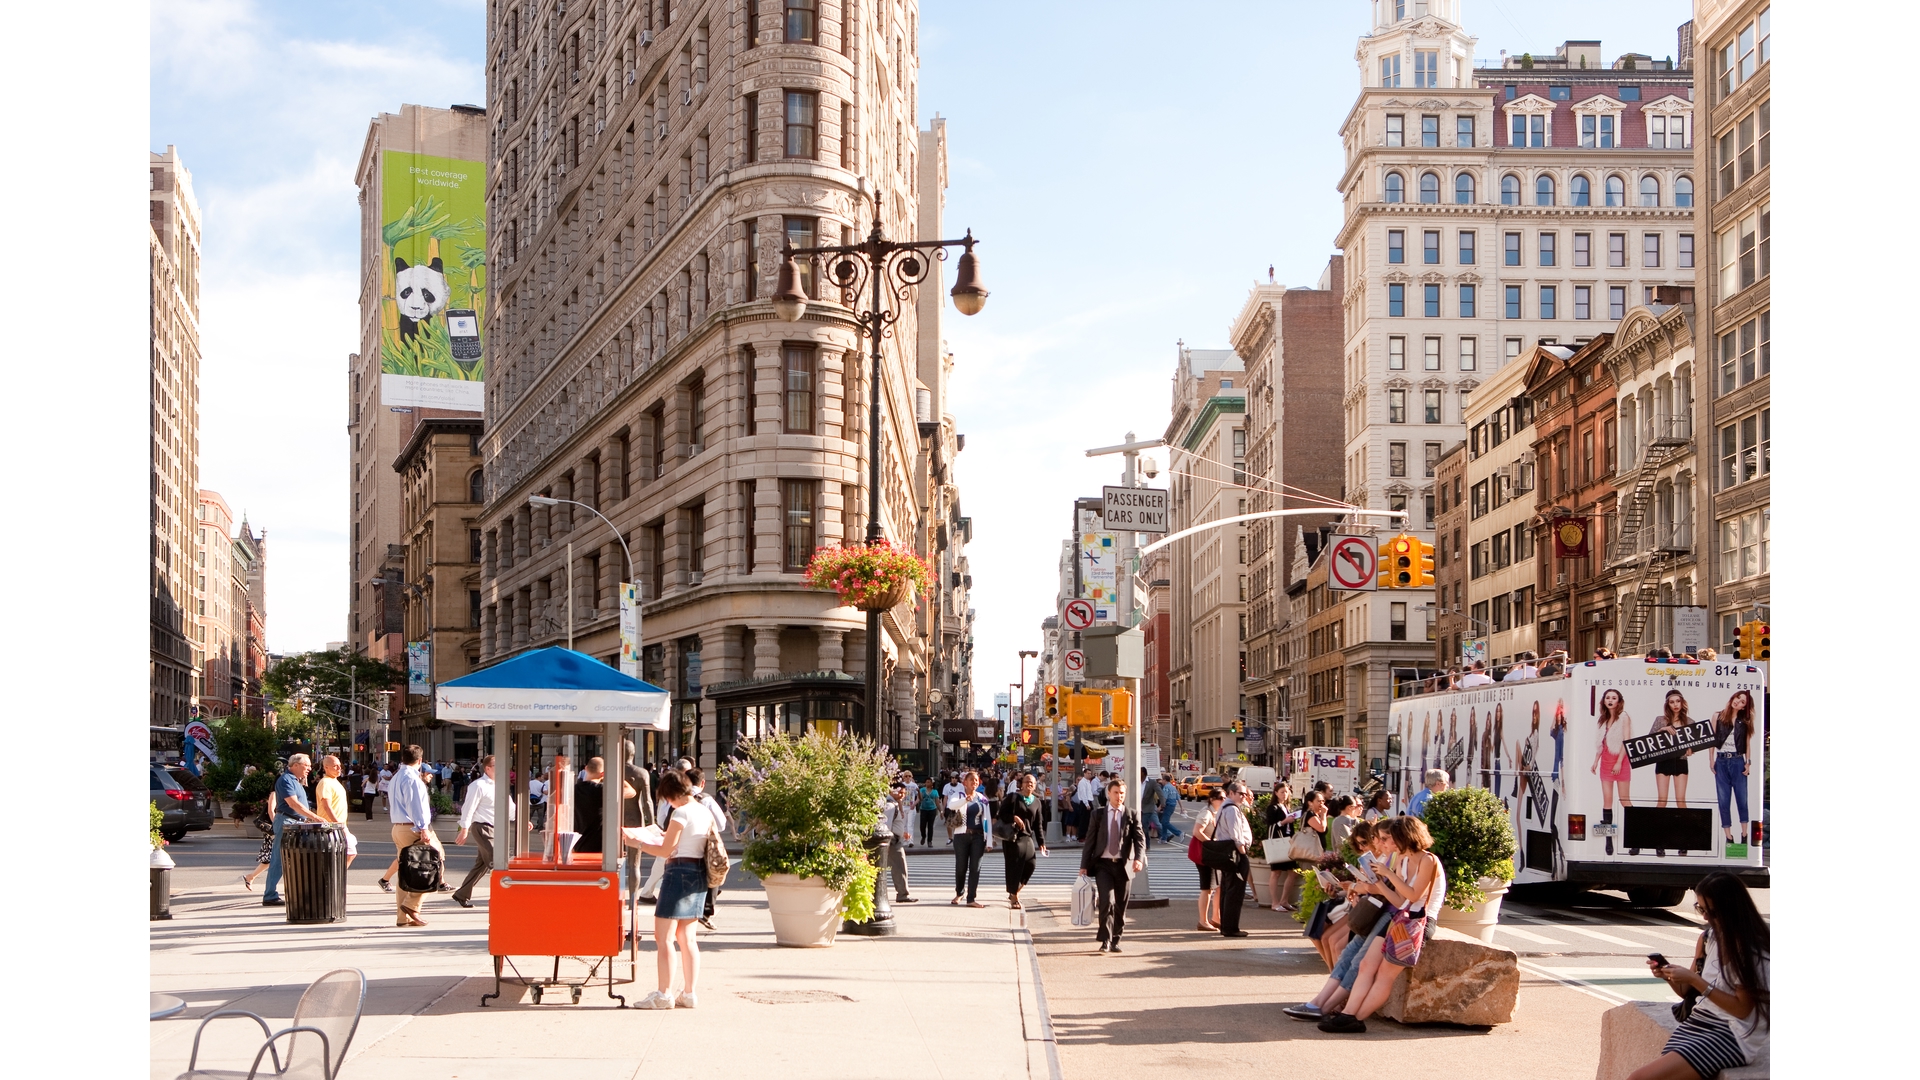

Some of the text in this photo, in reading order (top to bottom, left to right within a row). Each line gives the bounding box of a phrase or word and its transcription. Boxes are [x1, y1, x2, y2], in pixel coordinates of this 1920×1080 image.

[409, 166, 468, 181] Best coverage
[417, 177, 460, 189] worldwide.
[1107, 492, 1164, 508] PASSENGER
[1107, 509, 1164, 525] CARS ONLY
[1715, 665, 1738, 676] 814
[1737, 683, 1761, 691] 25TH
[1483, 690, 1497, 702] JUNE
[1499, 688, 1514, 701] 25TH
[455, 701, 486, 709] Flatiron
[487, 702, 506, 710] 23rd
[533, 703, 577, 712] Partnership
[1625, 726, 1695, 758] FOREVER
[1696, 721, 1714, 738] 21
[1179, 763, 1200, 772] FedEx
[1314, 754, 1355, 769] FedEx
